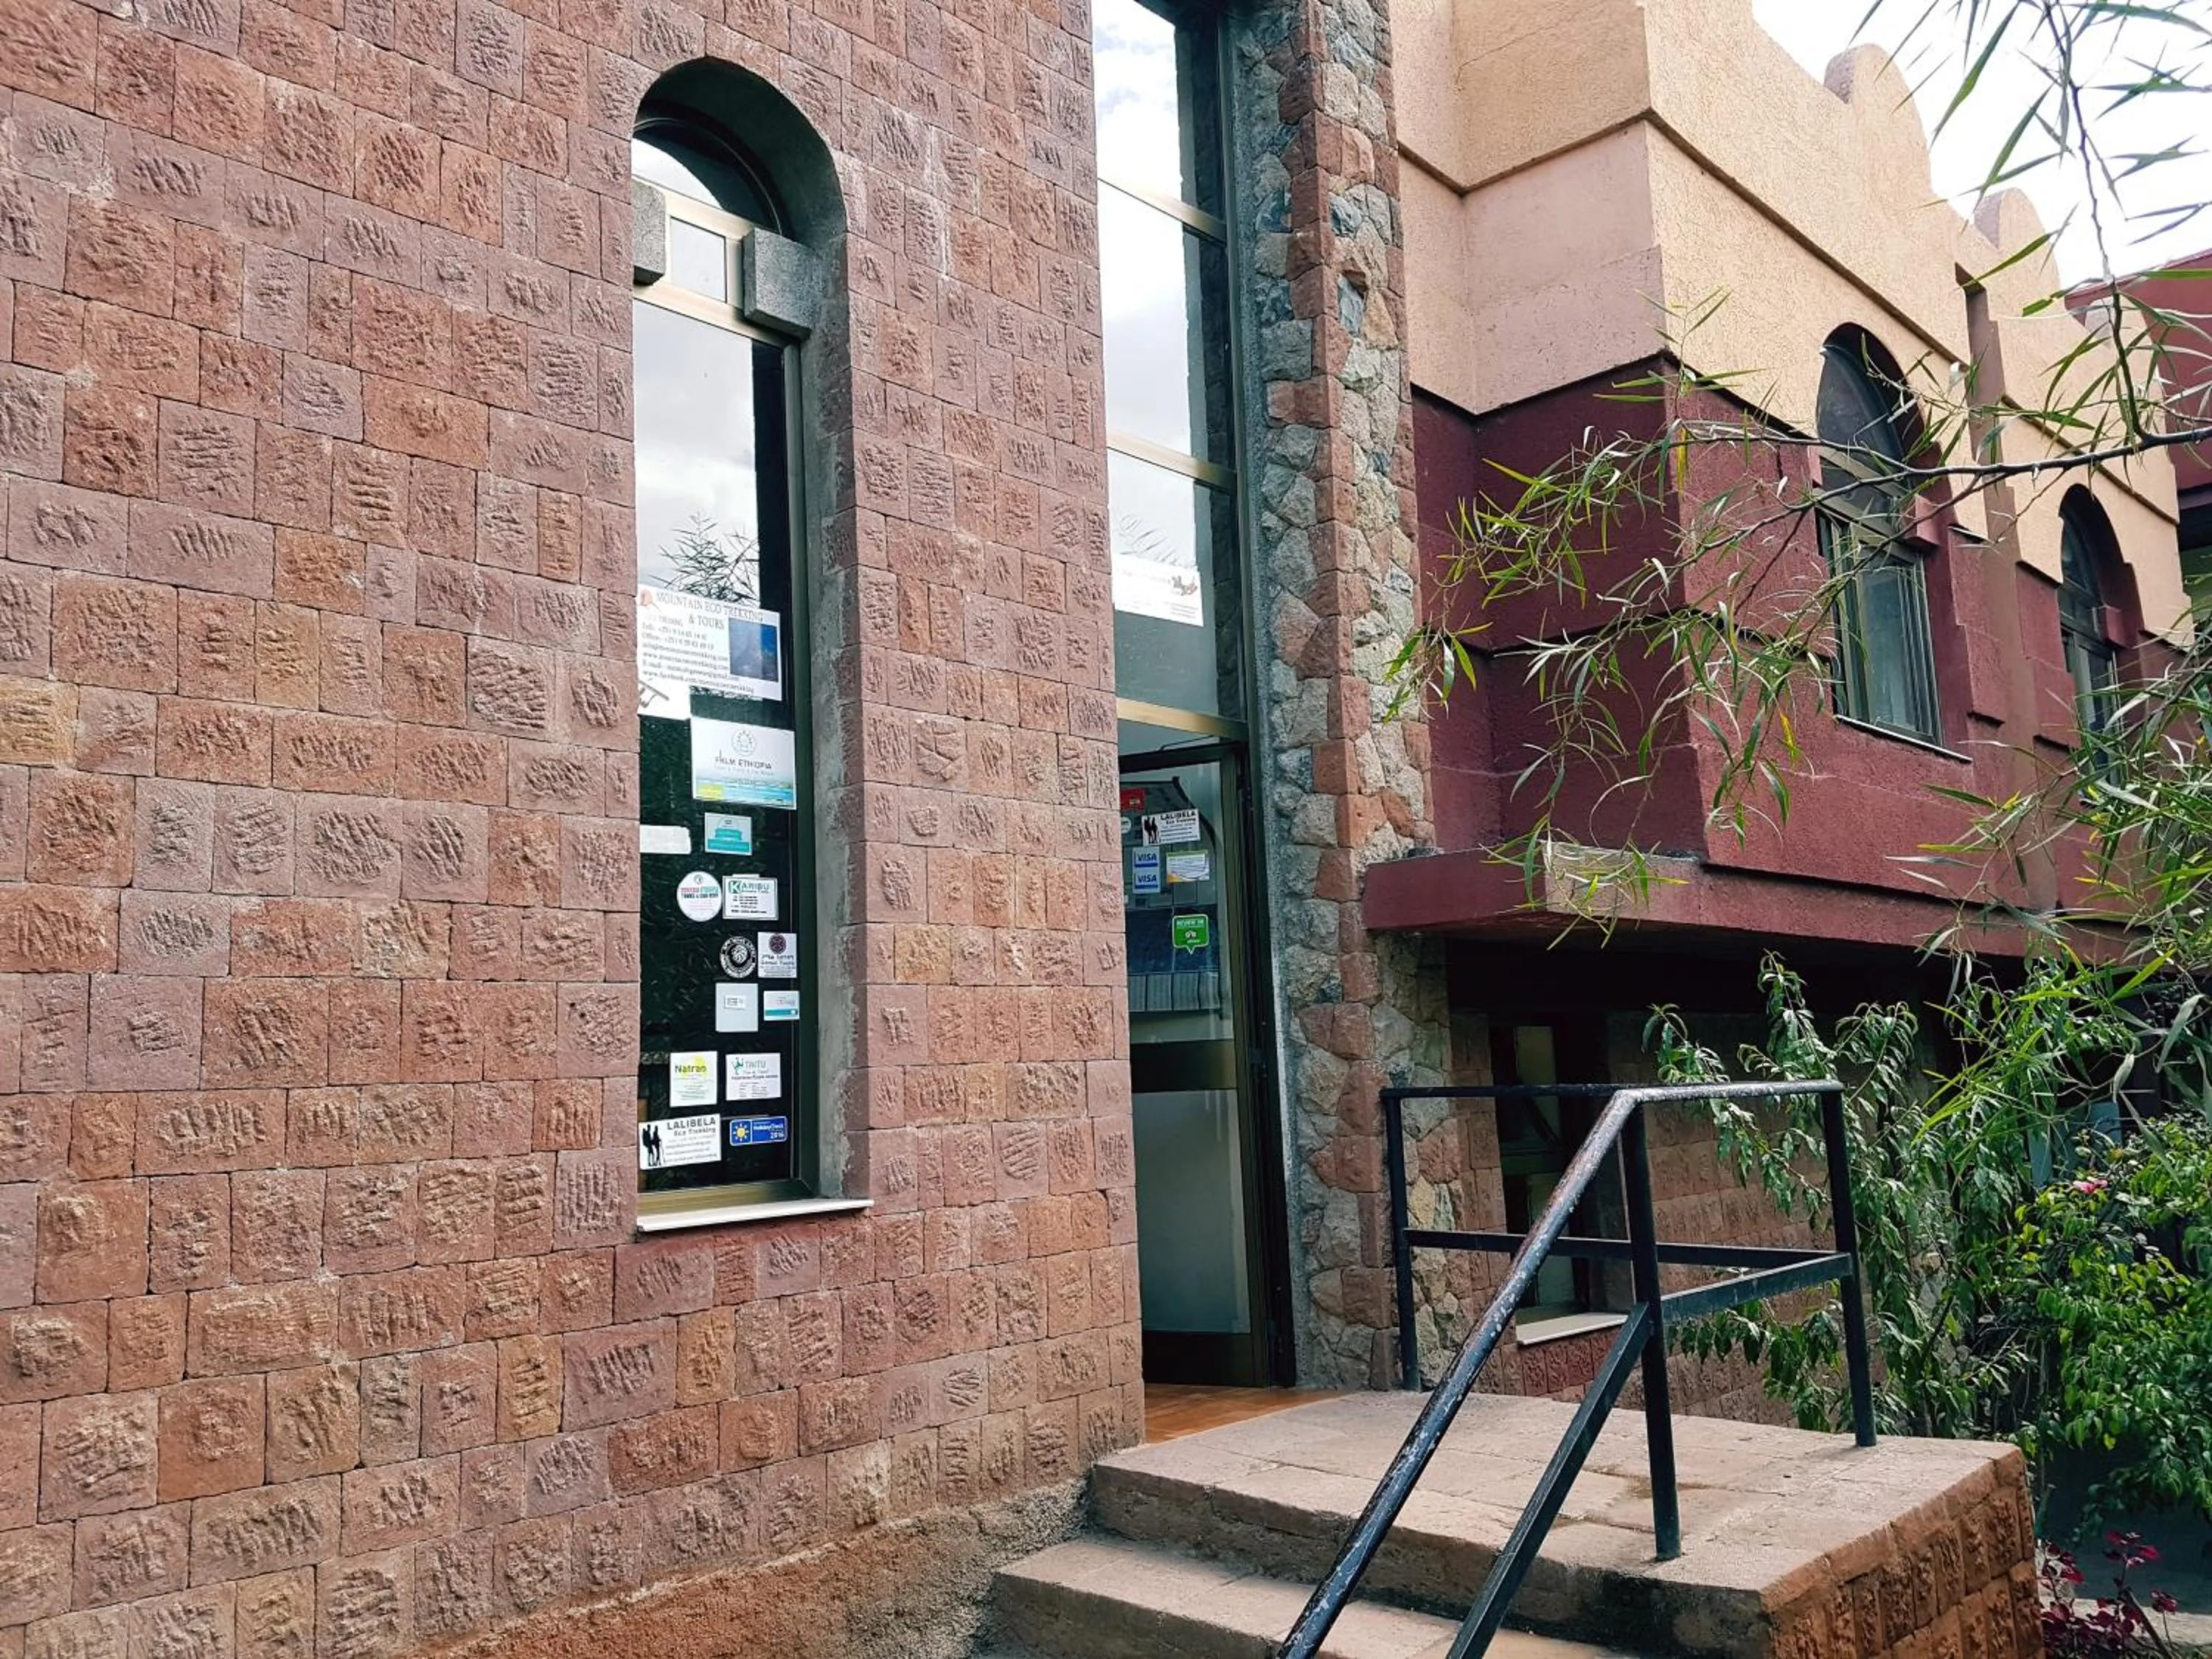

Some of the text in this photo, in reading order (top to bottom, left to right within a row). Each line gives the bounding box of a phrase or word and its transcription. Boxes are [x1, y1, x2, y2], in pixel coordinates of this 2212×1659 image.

[656, 592, 703, 610] MOUNTAIN
[704, 602, 722, 614] ECO
[696, 615, 725, 630] TOURS
[1137, 853, 1157, 862] VISA
[1137, 874, 1157, 883] VISA
[728, 880, 770, 894] KARIBU
[667, 1117, 716, 1130] LALIBELA
